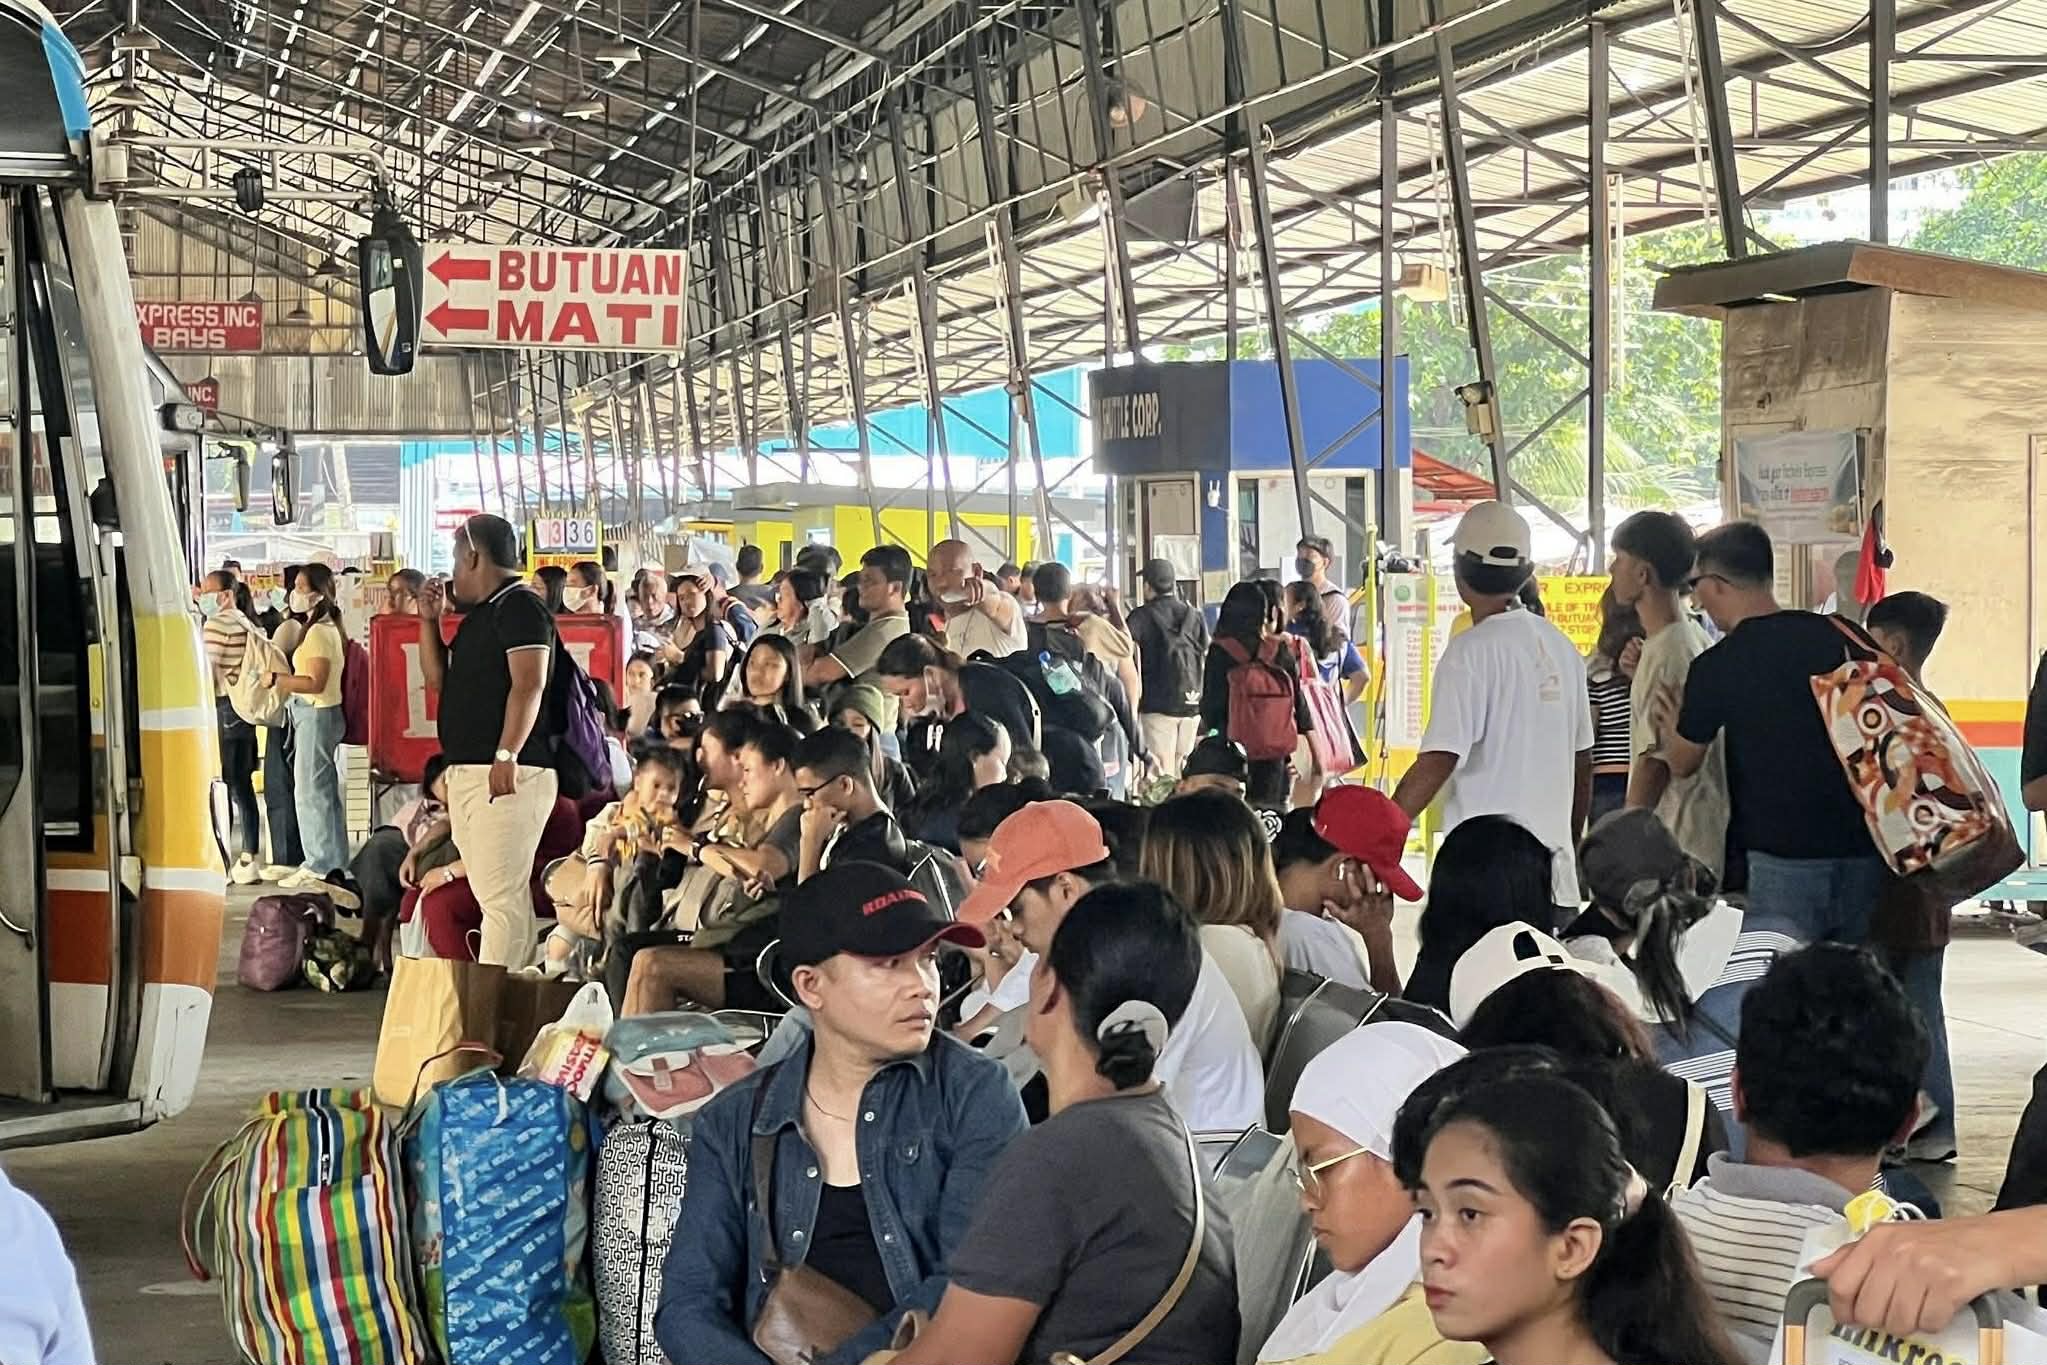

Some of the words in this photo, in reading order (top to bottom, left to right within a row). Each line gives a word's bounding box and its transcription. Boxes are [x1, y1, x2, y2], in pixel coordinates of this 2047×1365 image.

[499, 250, 681, 296] BUTUAN
[153, 327, 227, 349] BAYS
[496, 300, 680, 346] MATI
[1132, 392, 1161, 438] CORP.
